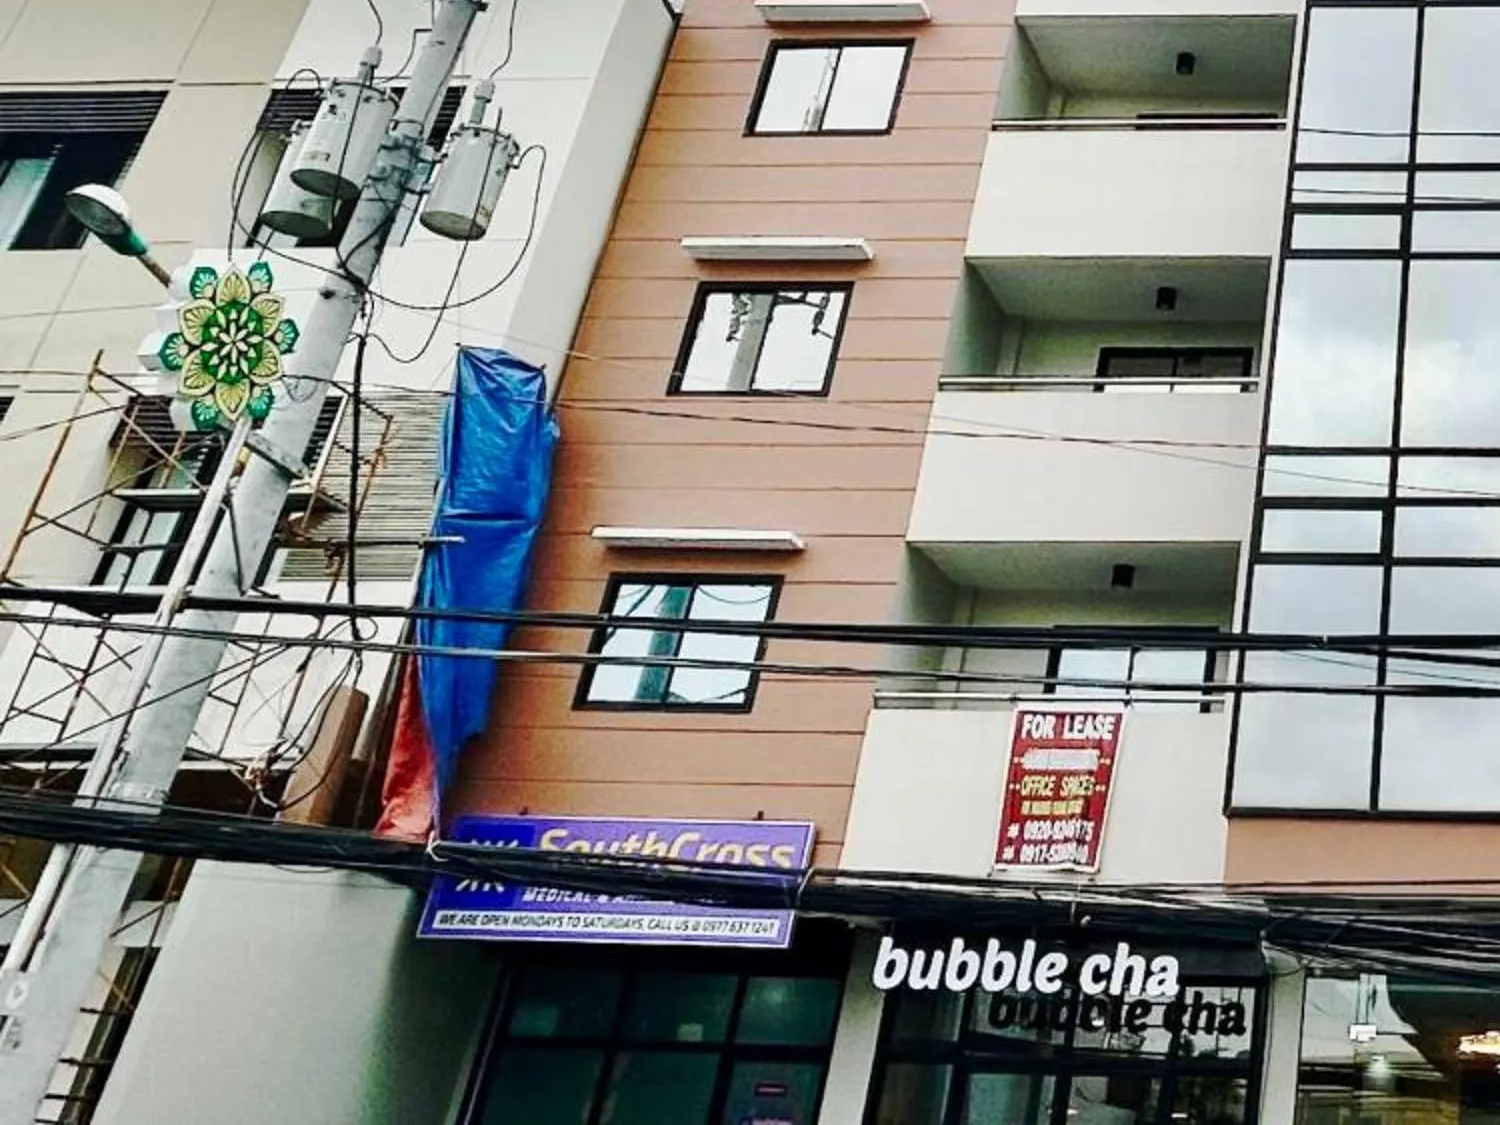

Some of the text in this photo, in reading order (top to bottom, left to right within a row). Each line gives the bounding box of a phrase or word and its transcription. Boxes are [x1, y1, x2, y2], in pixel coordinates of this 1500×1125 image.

[1021, 714, 1116, 740] FOR LEASE
[1020, 775, 1056, 796] OFFICE
[439, 913, 456, 925] WE
[456, 914, 480, 925] ARE
[480, 914, 510, 926] OPEN
[511, 914, 563, 928] MONDAYS
[567, 915, 581, 928] TO
[646, 917, 671, 931] CALL
[673, 918, 689, 932] US
[872, 936, 1181, 996] bubble cha
